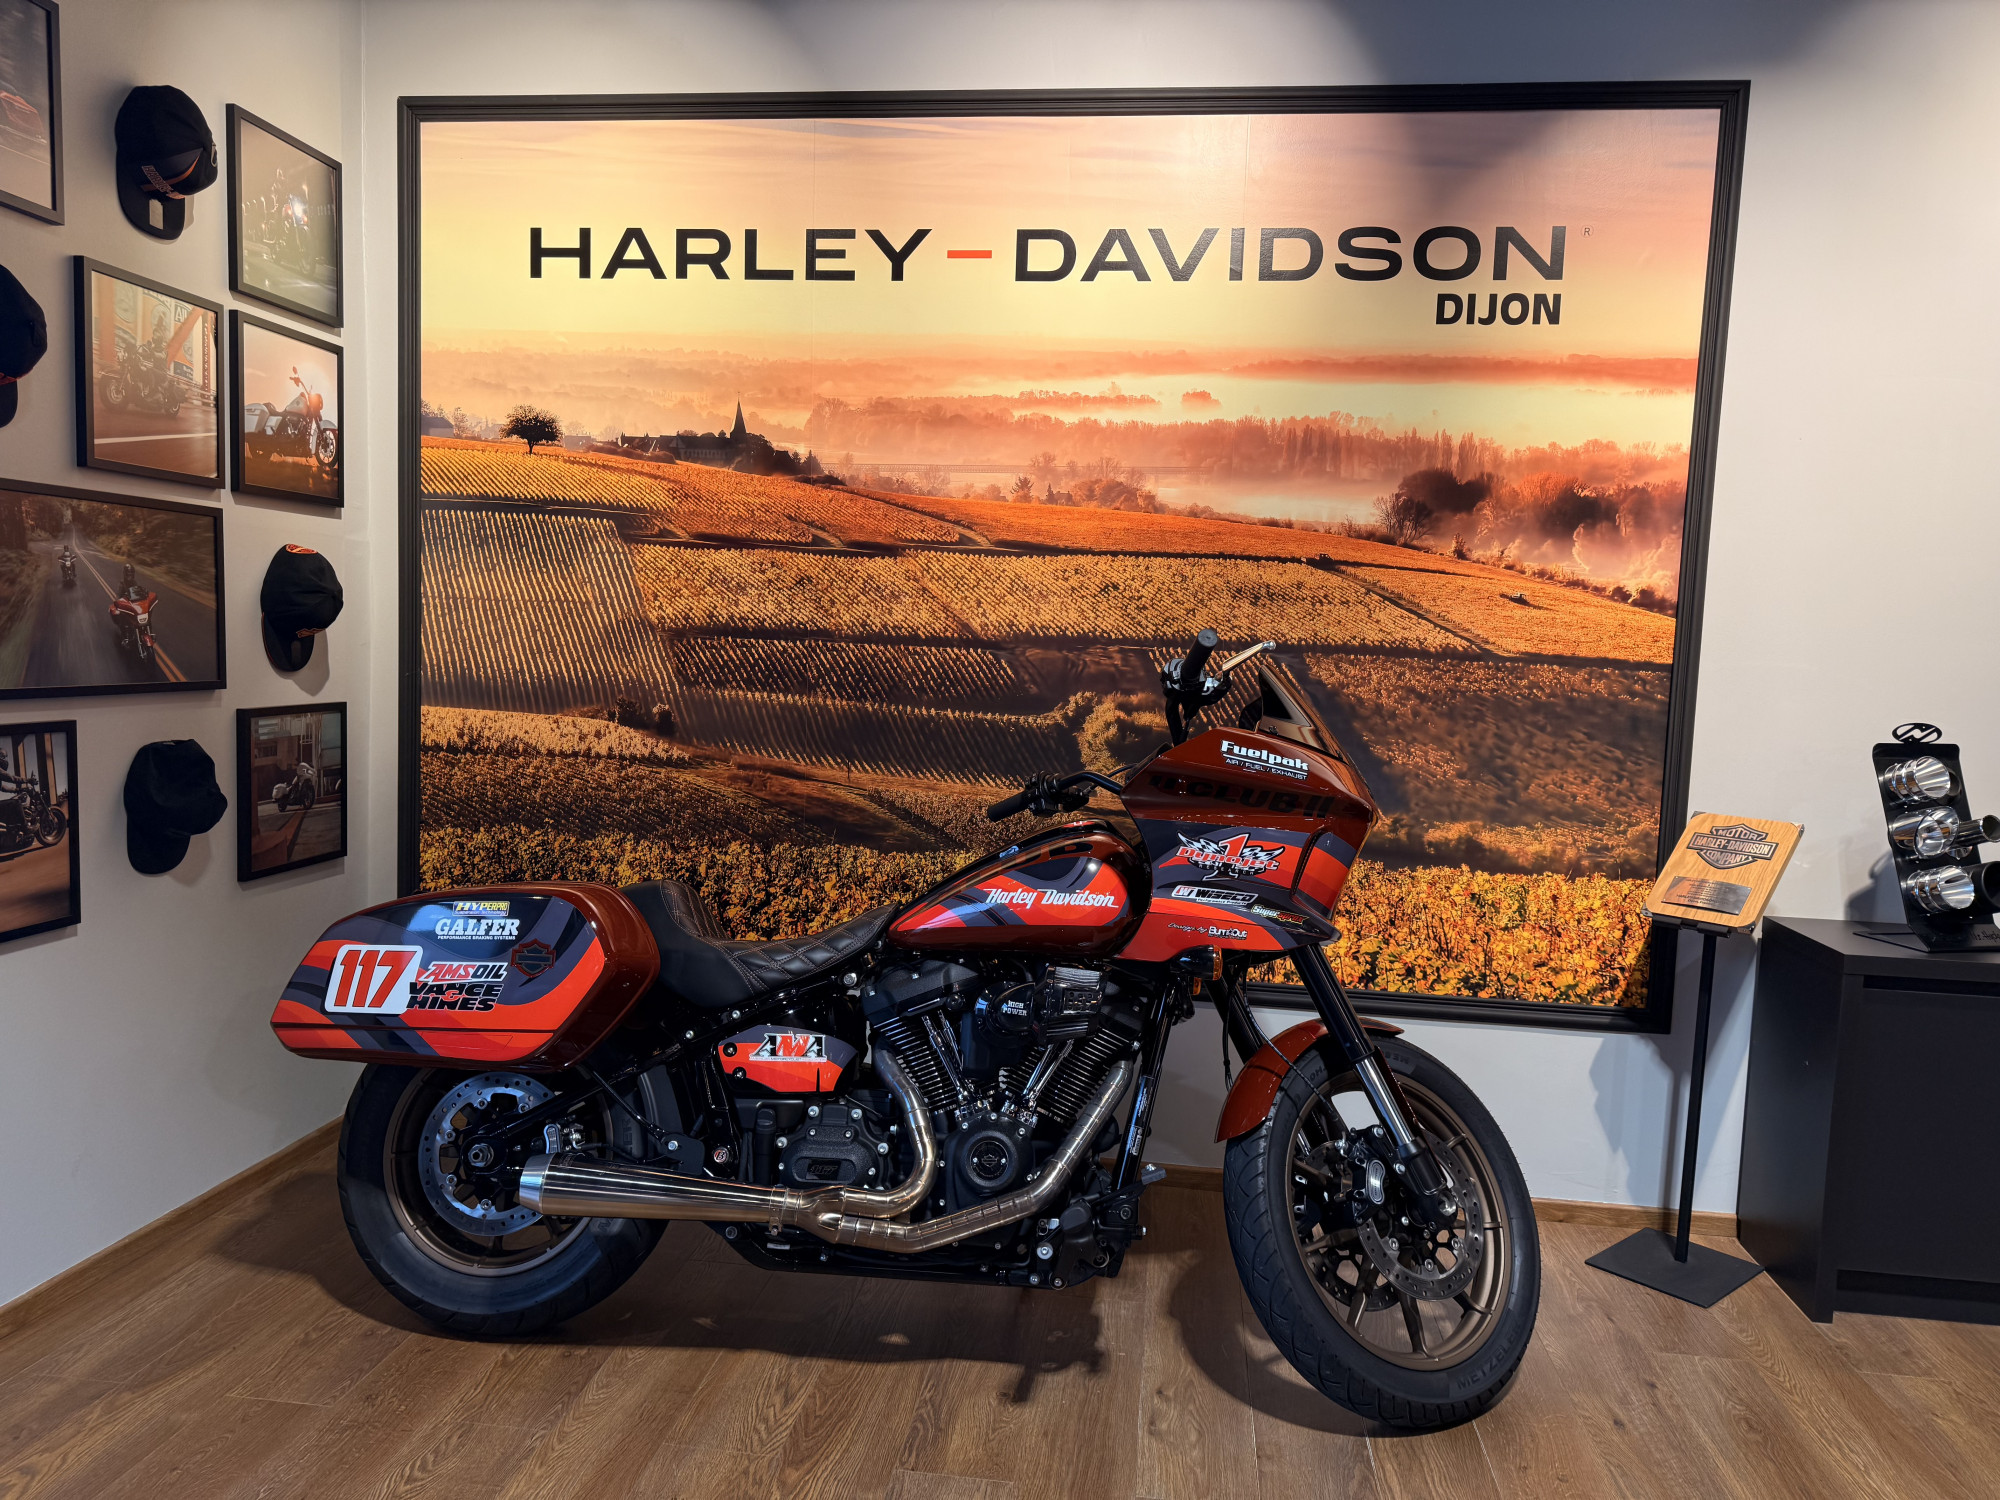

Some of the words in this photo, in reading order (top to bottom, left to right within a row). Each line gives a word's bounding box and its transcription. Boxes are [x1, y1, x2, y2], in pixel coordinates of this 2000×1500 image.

[1435, 293, 1561, 325] DIJON
[1220, 739, 1309, 771] Fuelpak
[1225, 758, 1239, 766] AIR
[1245, 762, 1265, 772] FUEL
[1271, 769, 1308, 781] EXHAUST
[1717, 827, 1758, 840] MOTOR
[1694, 836, 1771, 855] HARLEY-DAVIDSON
[1176, 846, 1280, 870] Dynojet
[1706, 850, 1748, 866] COMPANY
[456, 902, 508, 911] HYPERPRO
[983, 888, 1037, 909] Harley
[1037, 888, 1119, 908] Davidson
[435, 918, 520, 936] GALFER
[334, 950, 417, 1008] 117
[423, 963, 508, 981] AMSOIL
[409, 982, 504, 998] VANCE
[406, 996, 498, 1011] HINES
[753, 1033, 826, 1057] AMA
